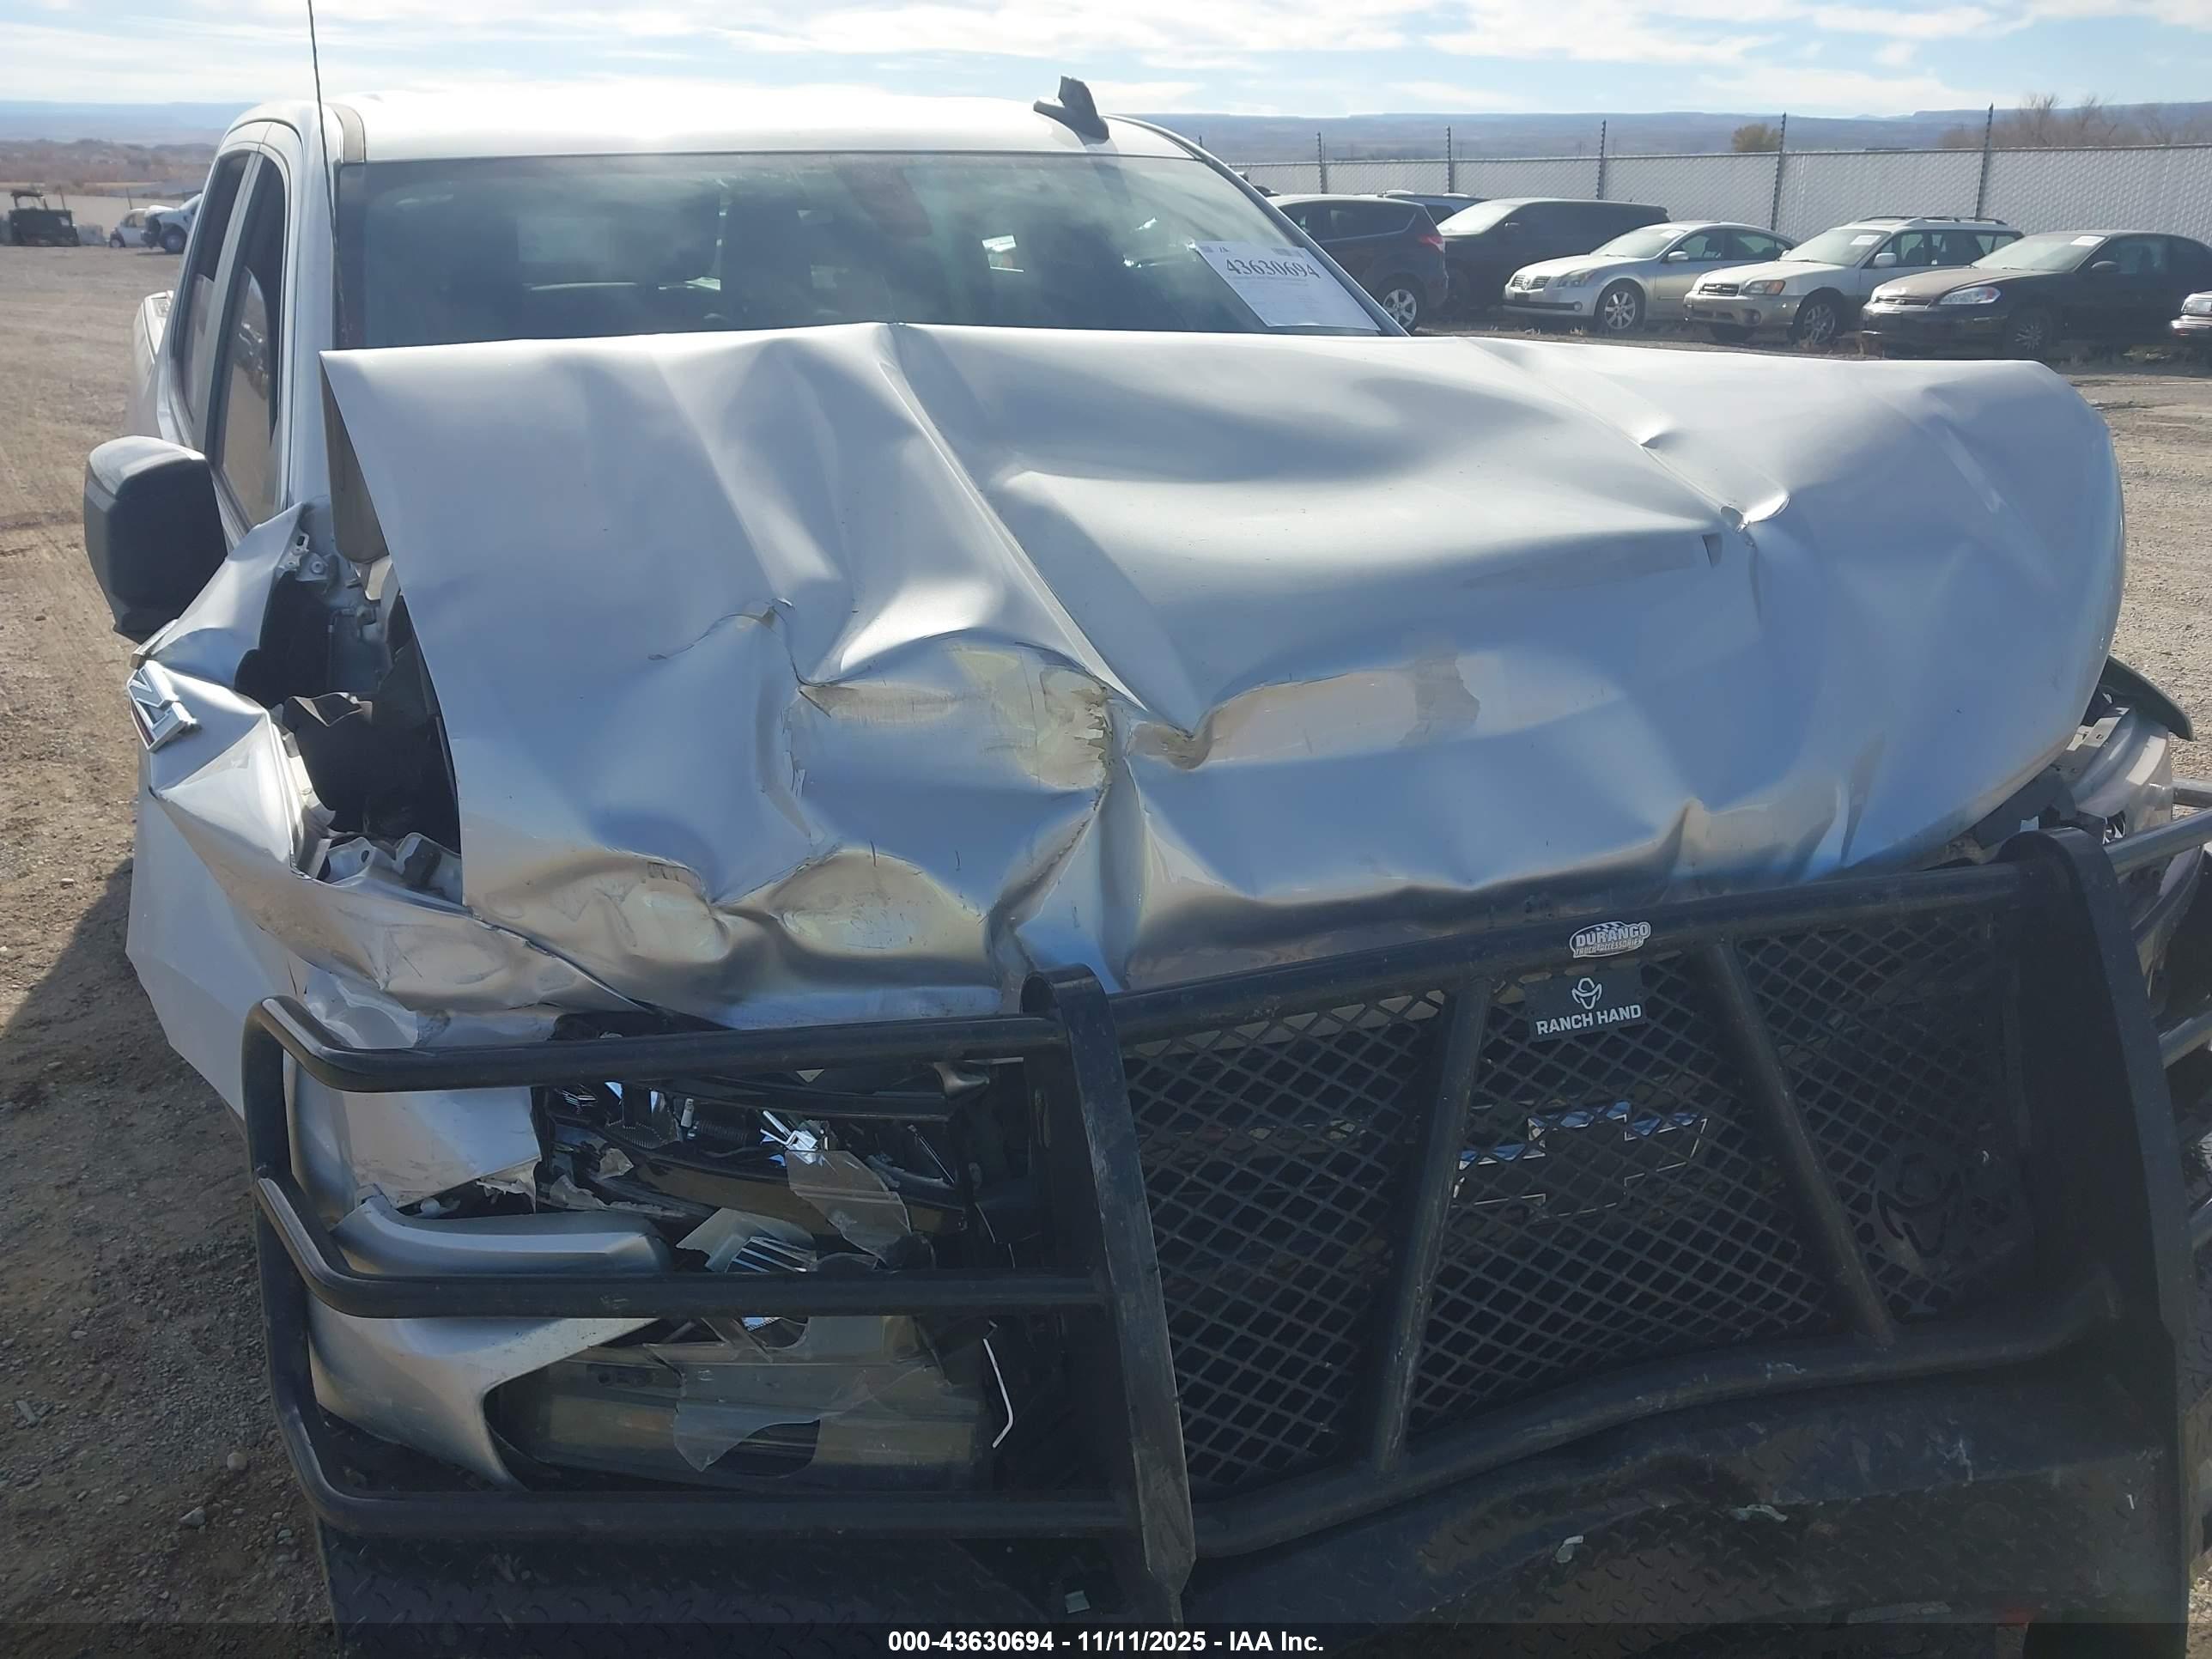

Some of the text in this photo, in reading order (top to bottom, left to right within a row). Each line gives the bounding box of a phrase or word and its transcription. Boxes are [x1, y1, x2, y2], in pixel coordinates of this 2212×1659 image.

[1225, 258, 1321, 279] 43630694
[1575, 924, 1649, 947] DURANGO
[1536, 1004, 1642, 1036] RANCH HAND
